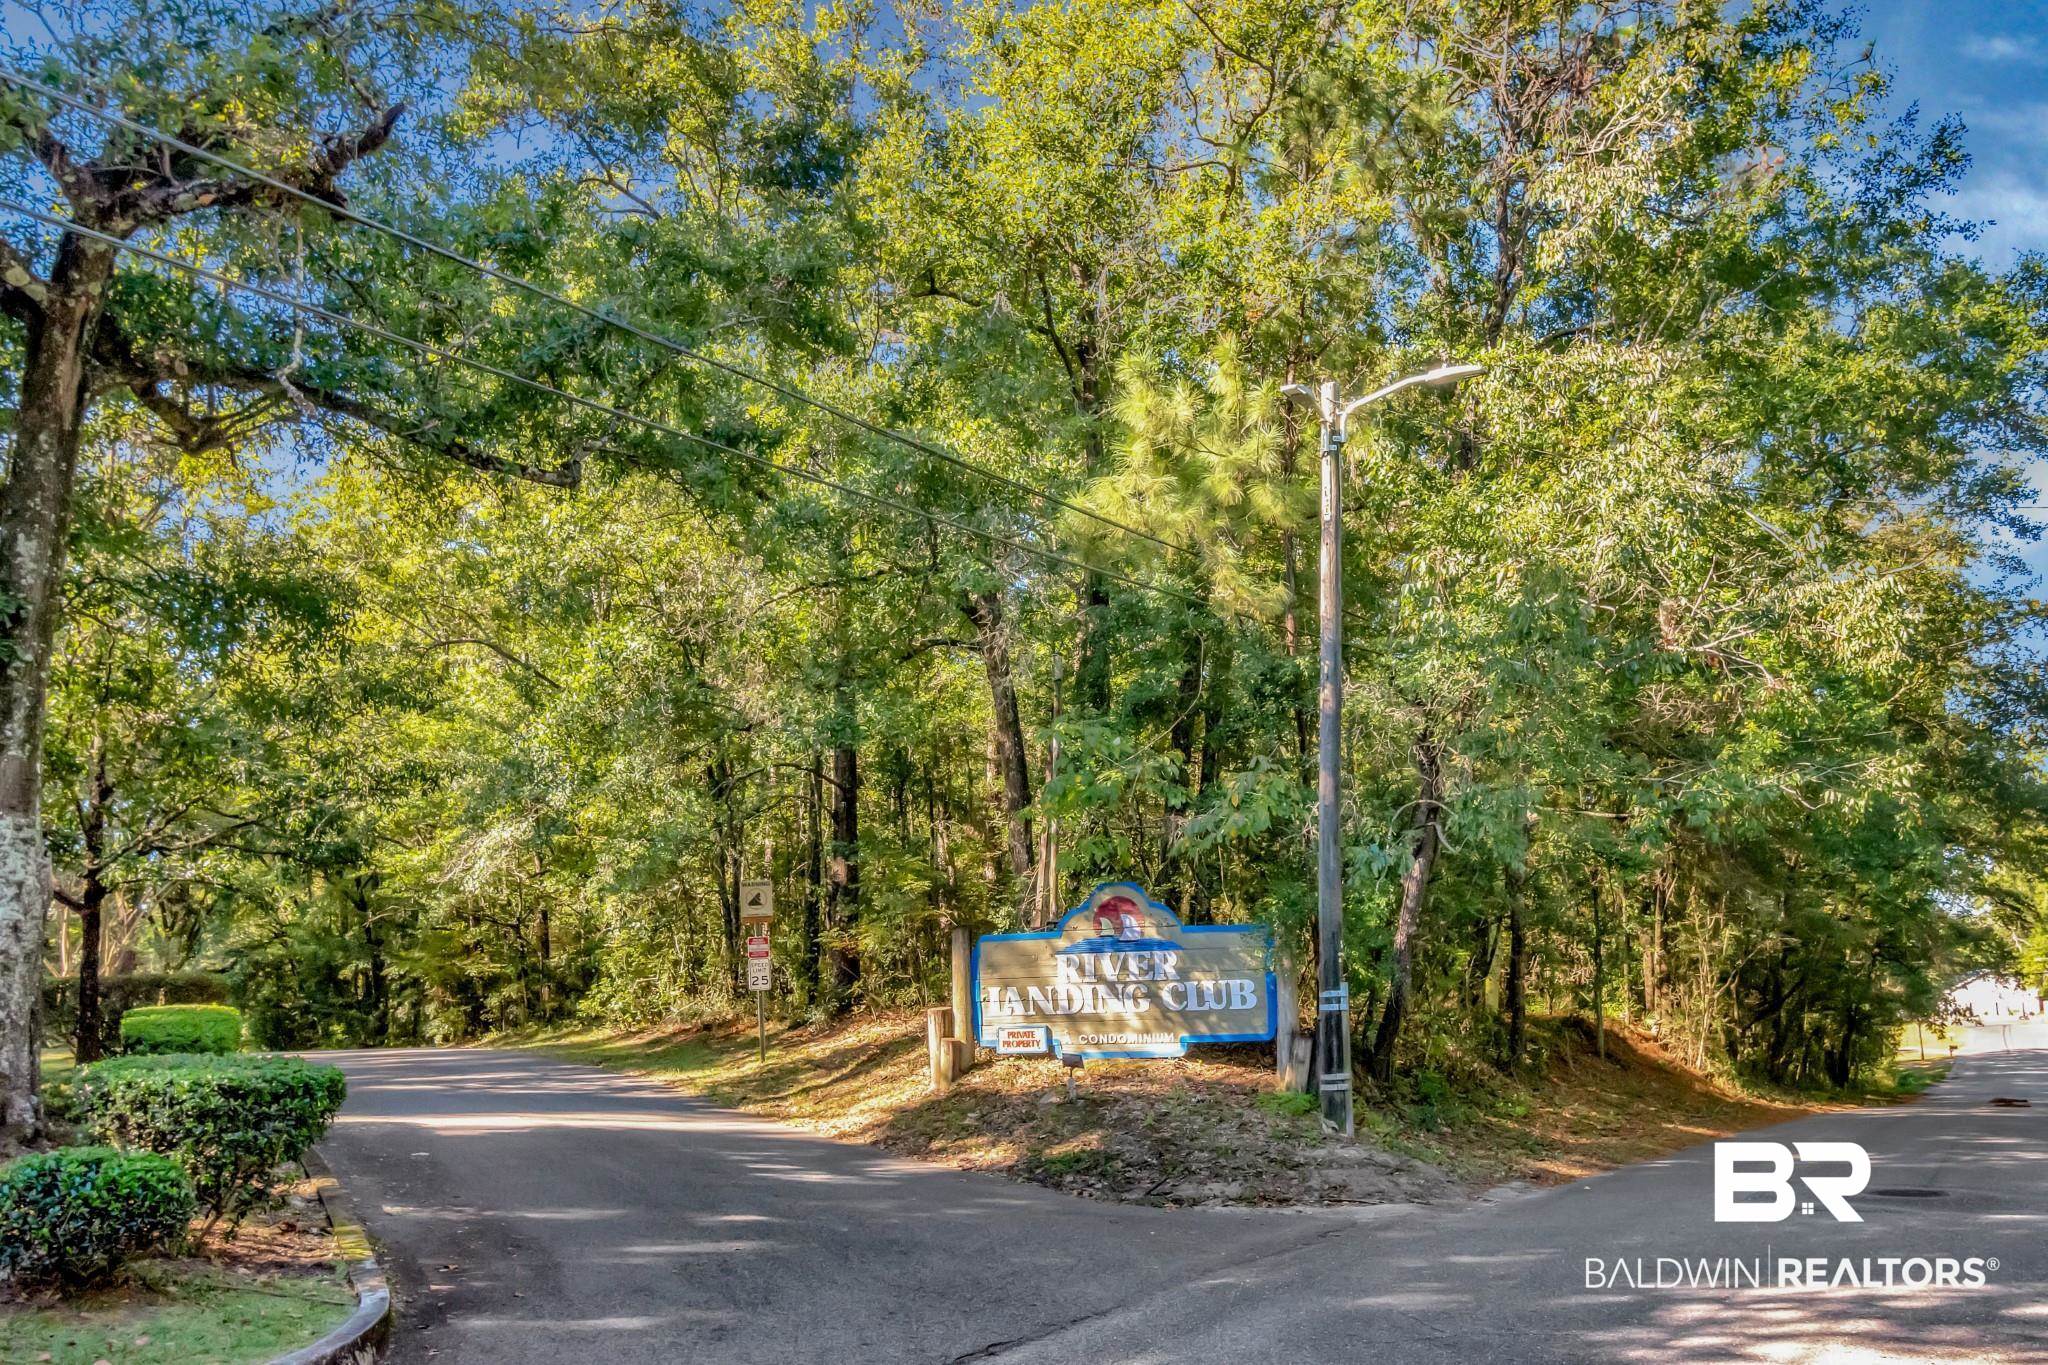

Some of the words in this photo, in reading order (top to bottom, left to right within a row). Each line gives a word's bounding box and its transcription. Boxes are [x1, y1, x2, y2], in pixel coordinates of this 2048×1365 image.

[1055, 951, 1181, 984] RIVER
[751, 975, 769, 986] 25
[982, 983, 1151, 1017] LANDING
[1162, 979, 1258, 1012] CLUB
[1007, 1030, 1036, 1039] PRIVATE
[1062, 1031, 1072, 1045] A
[1078, 1032, 1175, 1045] CONDOMINIUM
[1002, 1039, 1041, 1048] PROPERTY
